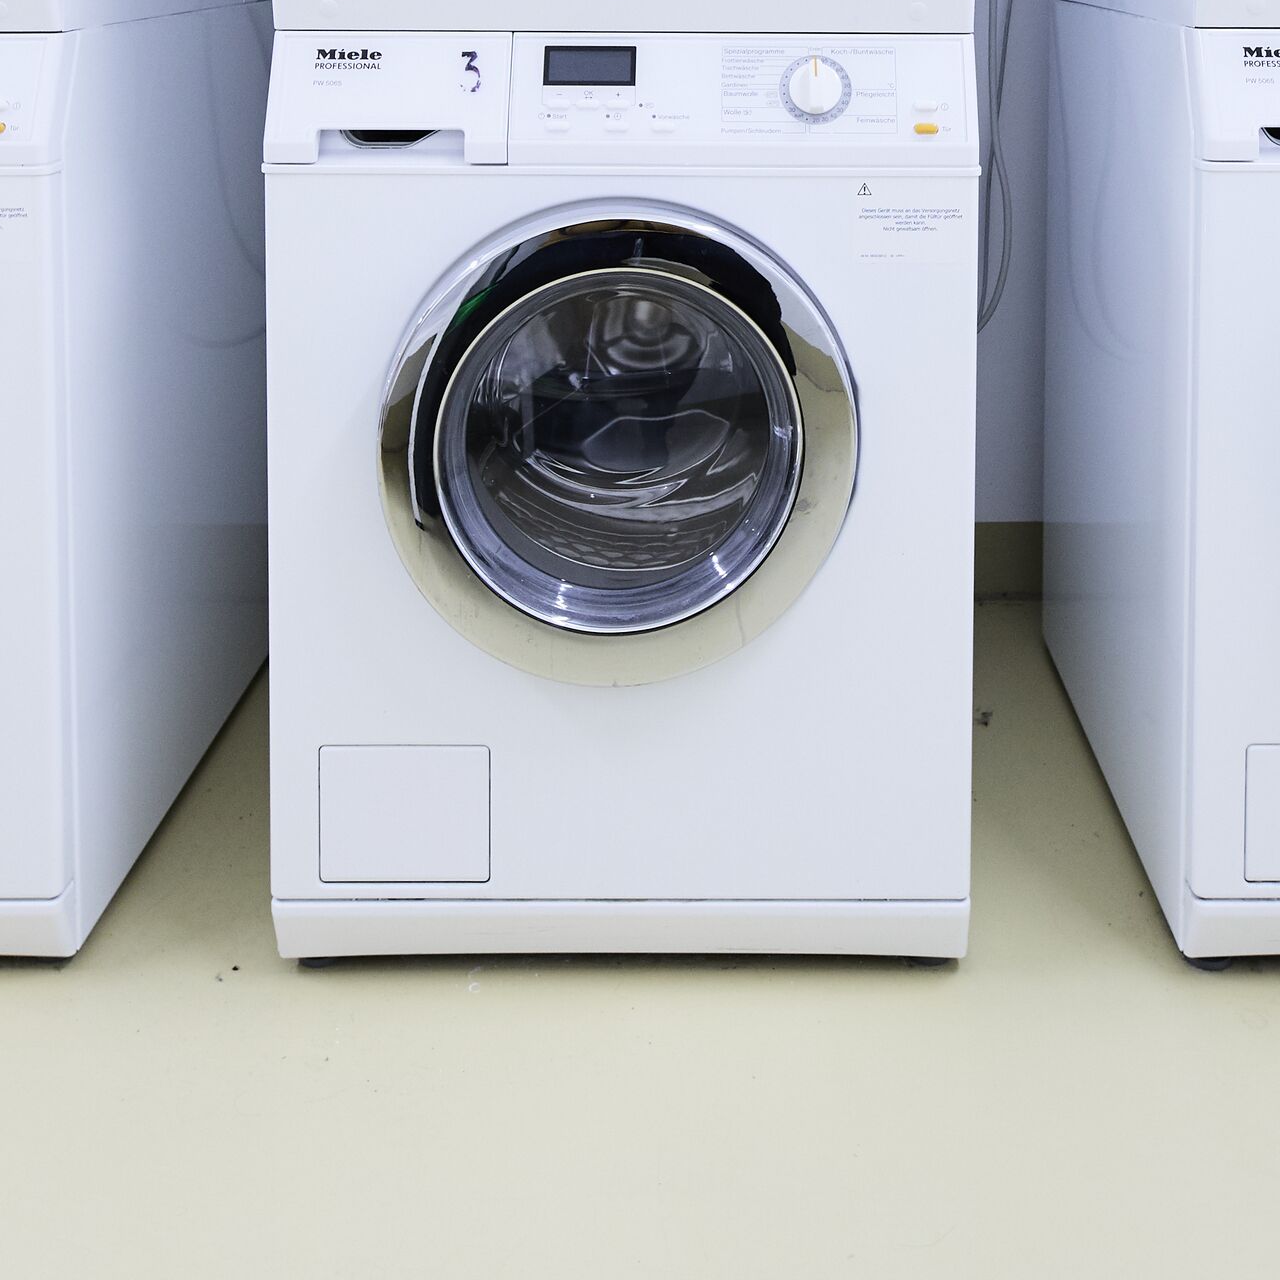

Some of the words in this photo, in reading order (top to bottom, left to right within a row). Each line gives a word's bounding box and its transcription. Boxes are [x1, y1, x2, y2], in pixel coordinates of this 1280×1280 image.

[315, 49, 383, 60] Miele
[314, 62, 381, 70] PROFESSIONAL
[459, 50, 482, 93] 3
